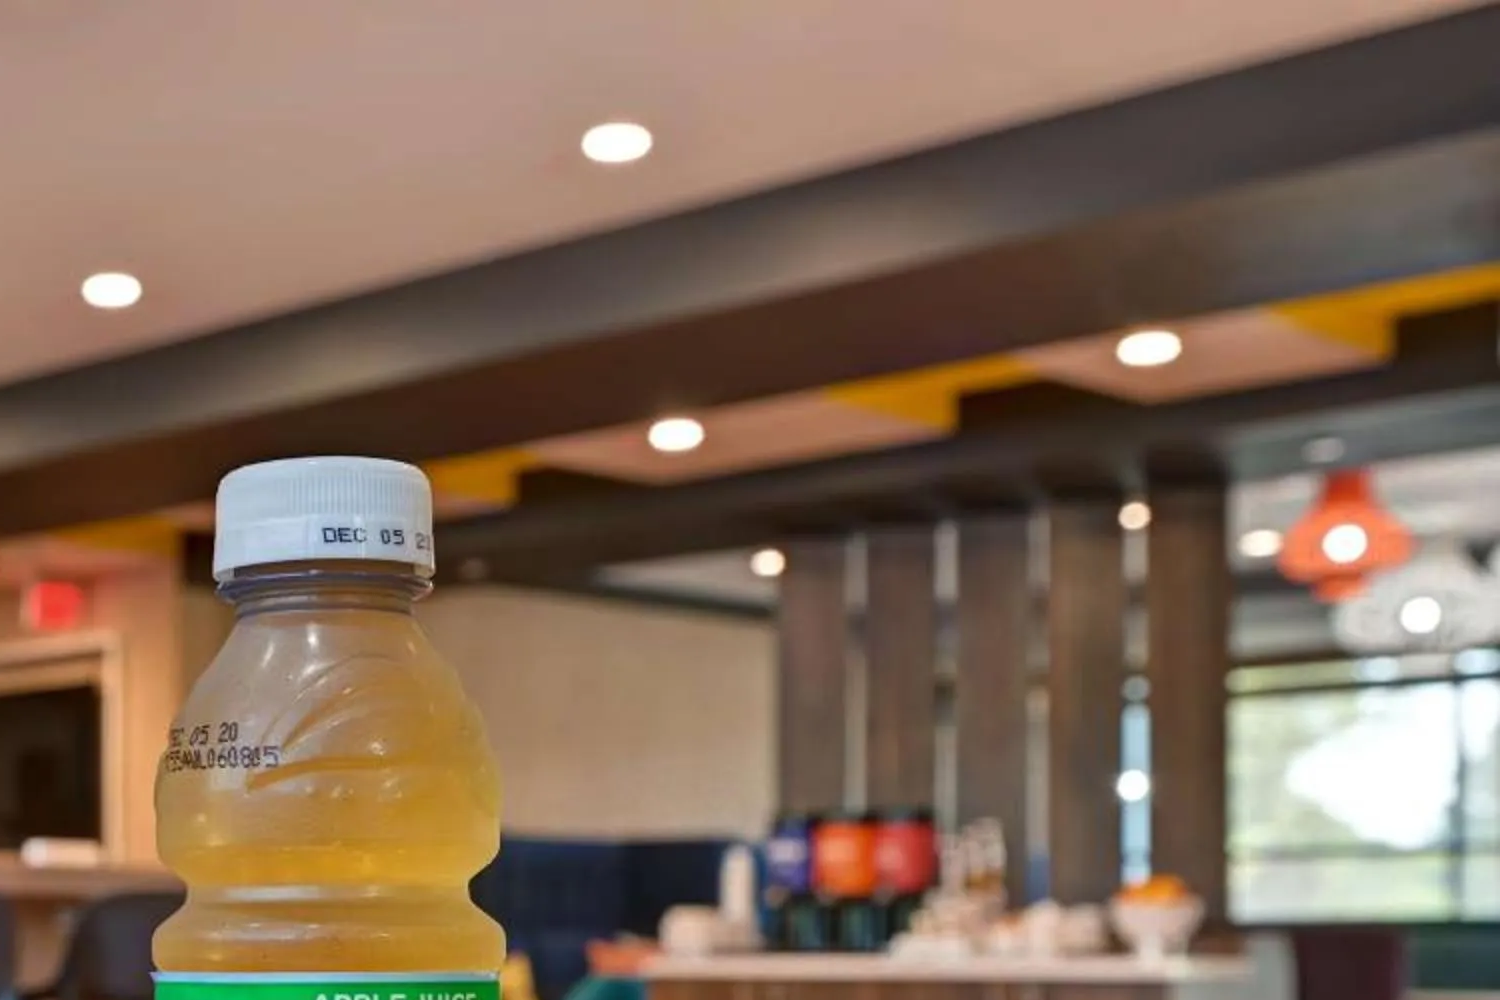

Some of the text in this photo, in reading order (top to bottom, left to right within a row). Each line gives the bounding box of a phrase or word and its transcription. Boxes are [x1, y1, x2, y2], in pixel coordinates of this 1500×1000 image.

[322, 527, 367, 543] DEC
[380, 529, 404, 545] 05
[218, 721, 239, 743] 20
